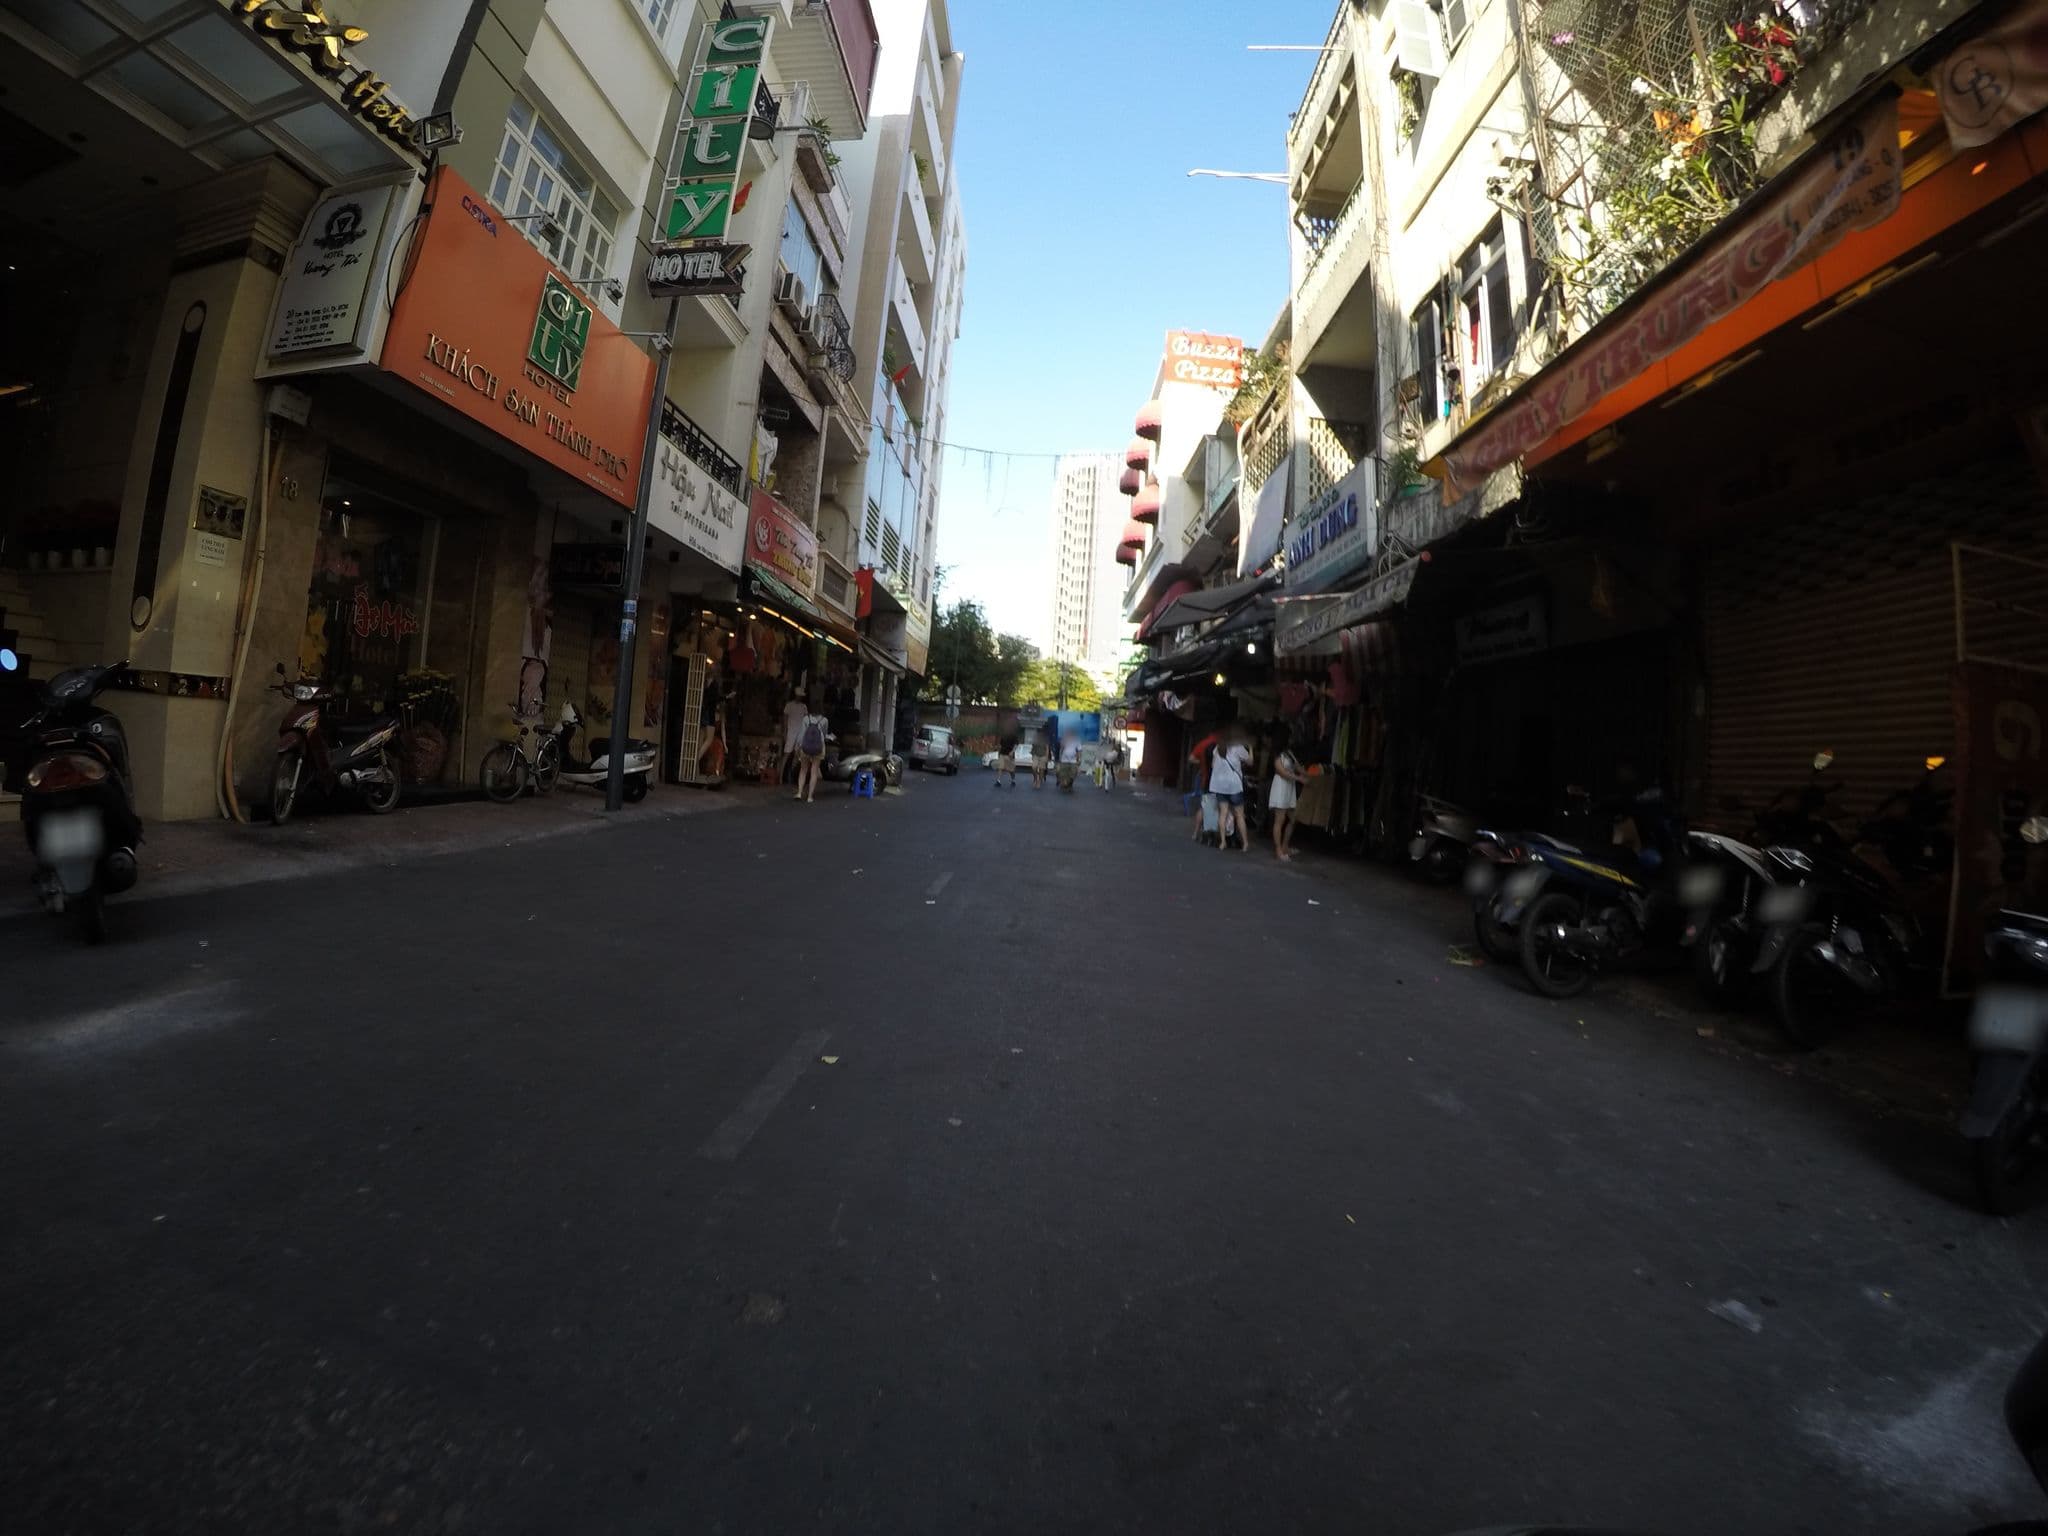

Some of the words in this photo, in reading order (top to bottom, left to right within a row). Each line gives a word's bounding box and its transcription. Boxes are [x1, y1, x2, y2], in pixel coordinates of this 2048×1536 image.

[323, 249, 344, 260] HOTEL
[648, 251, 725, 283] HOTEL
[424, 332, 501, 401] KHÁCH
[1174, 359, 1236, 384] Pizza
[522, 361, 575, 409] HOTEL
[280, 472, 298, 500] 18
[701, 481, 737, 529] Nail
